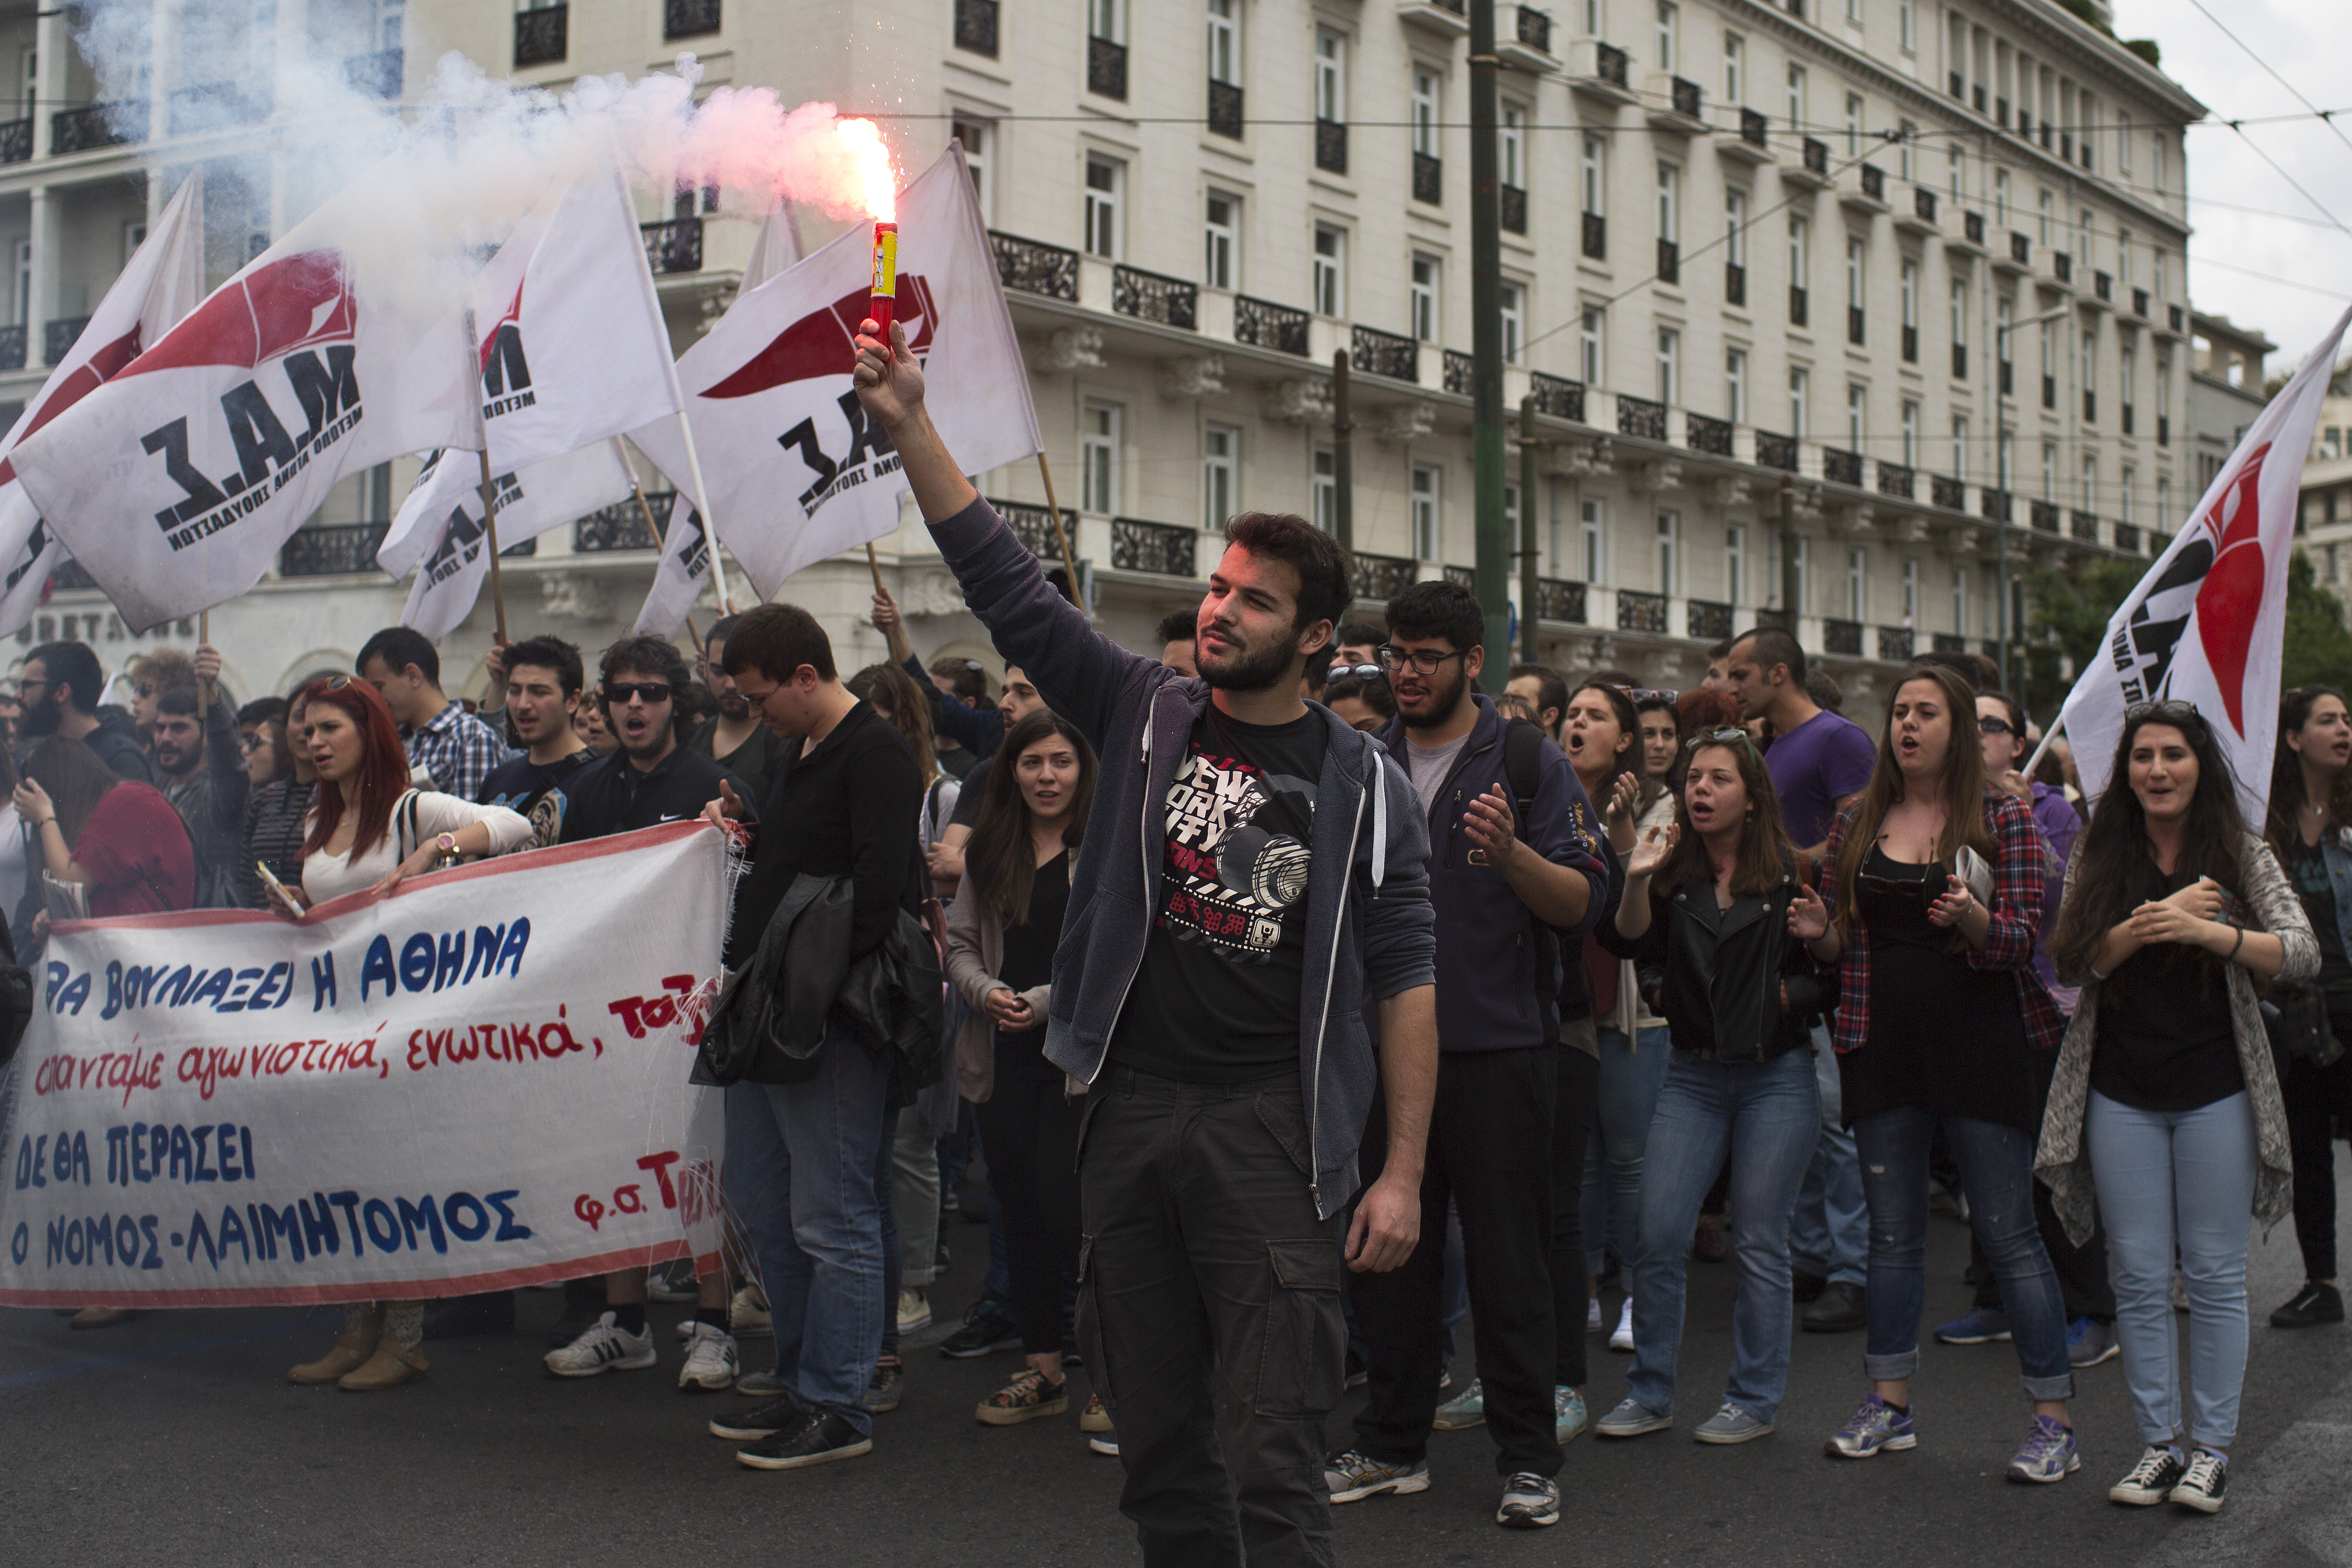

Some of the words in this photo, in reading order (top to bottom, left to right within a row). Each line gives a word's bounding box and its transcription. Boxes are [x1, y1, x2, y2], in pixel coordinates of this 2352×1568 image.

[1165, 806, 1228, 853] ITY
[1166, 783, 1236, 829] ORK
[100, 959, 294, 1021] ΒΟΥΛΙΑΞΕΙ
[311, 950, 337, 1012] Η
[360, 916, 530, 1003] ΑΘΗΝΑ
[16, 1134, 47, 1190] ΔΕ
[53, 1130, 91, 1186] ΘΑ
[105, 1122, 255, 1187] ΠΕΡΑΣΕΙ
